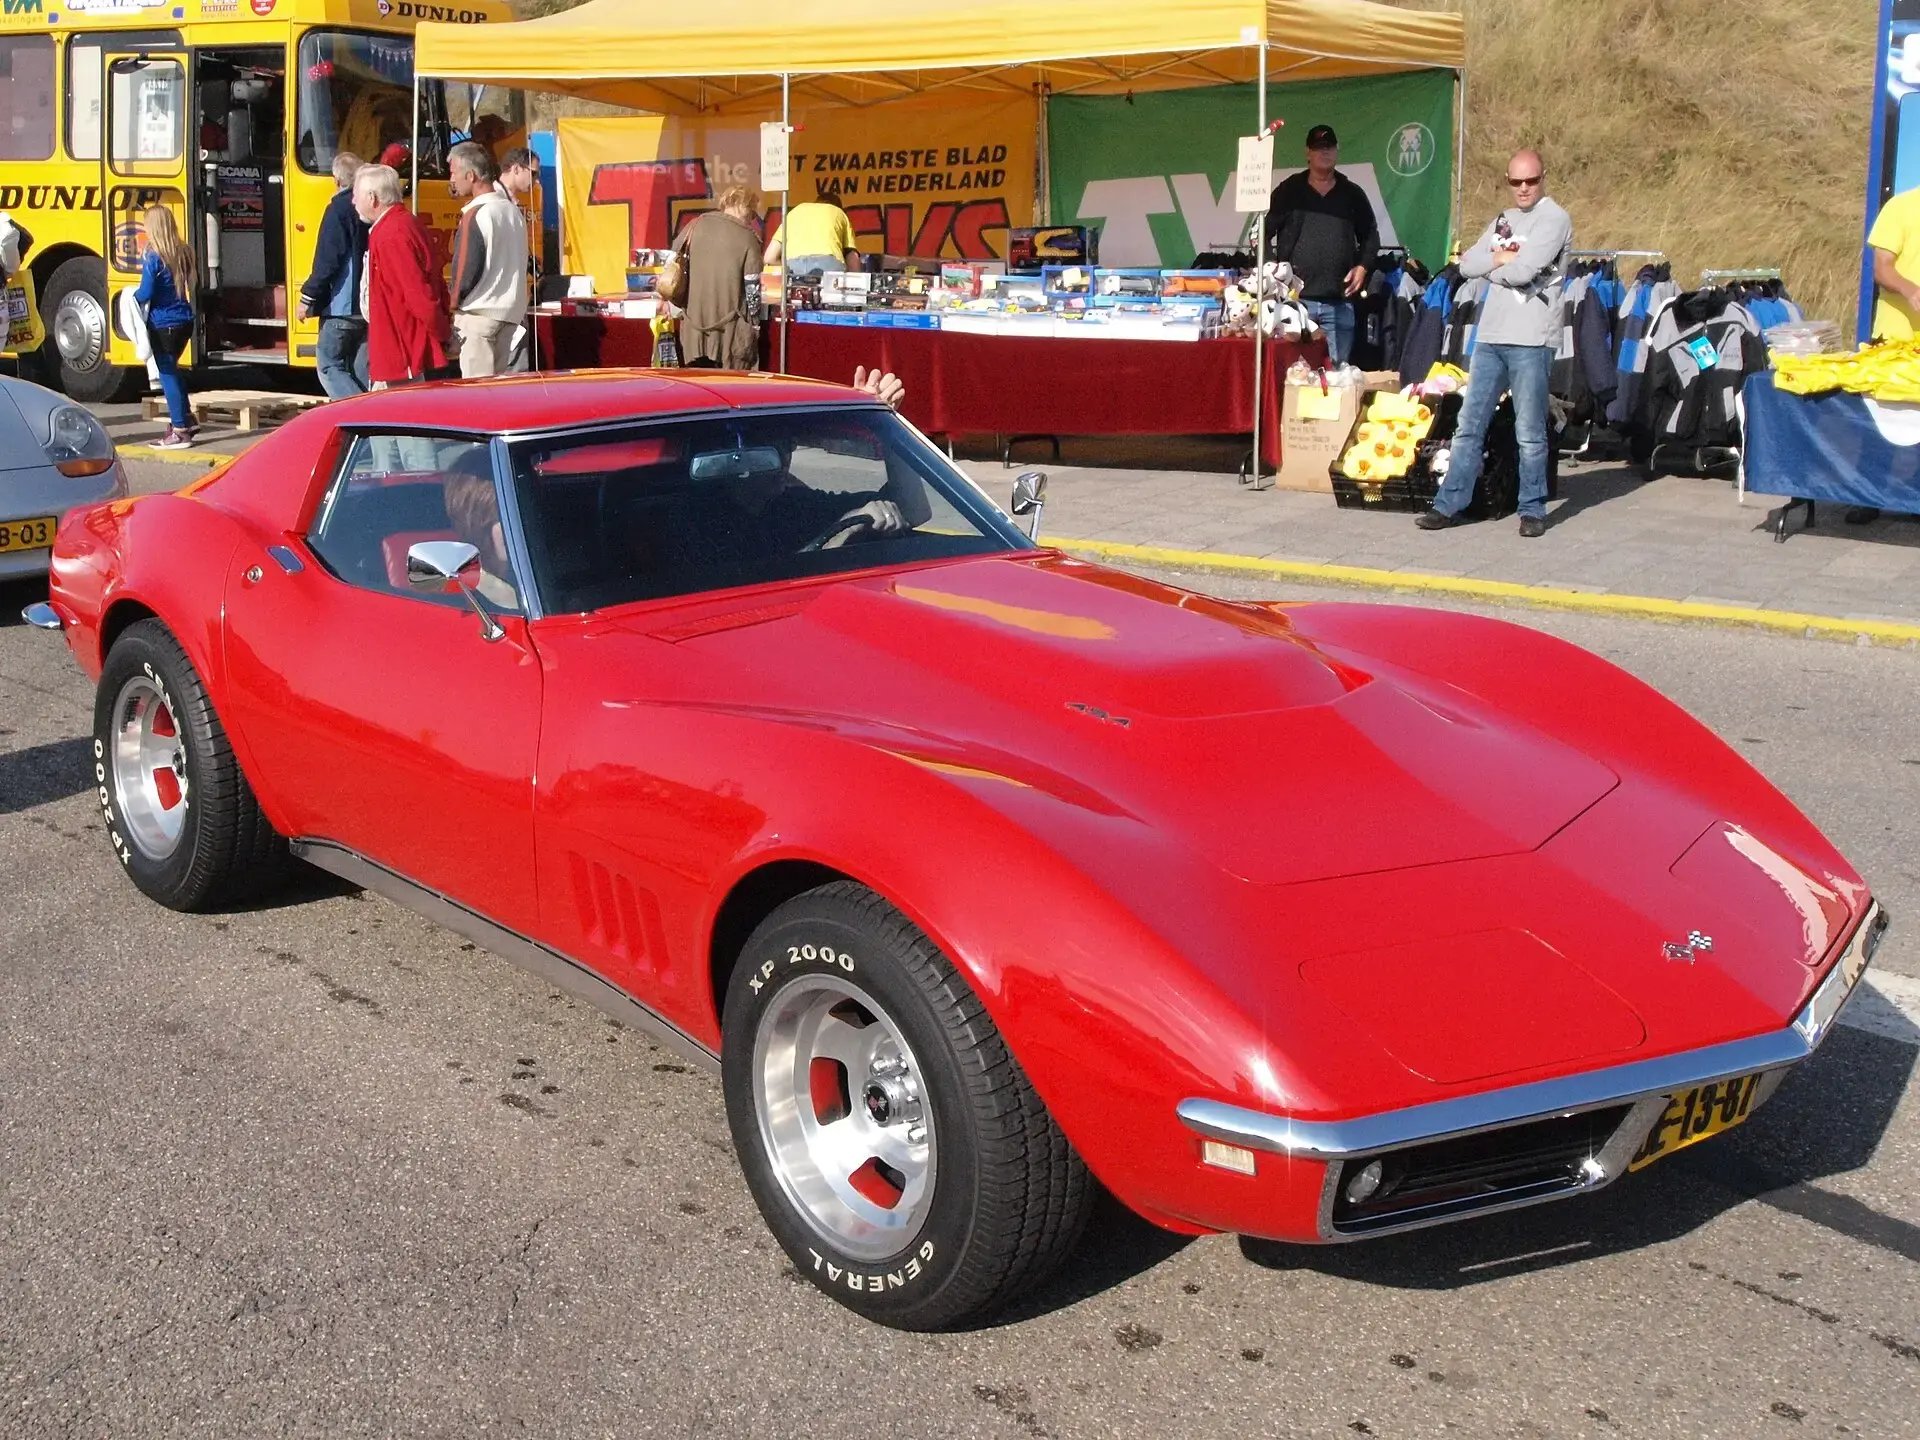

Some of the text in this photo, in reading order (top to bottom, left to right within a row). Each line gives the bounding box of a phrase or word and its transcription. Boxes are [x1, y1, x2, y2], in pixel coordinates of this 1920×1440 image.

[397, 2, 488, 24] DUNLOP
[814, 149, 938, 172] ZWAARSTE
[946, 145, 1008, 166] BLAD
[218, 167, 260, 178] SCANIA
[815, 169, 1006, 195] VAN NEDERLAND
[0, 185, 162, 212] DUNLOP
[749, 944, 855, 996] XP 2000
[809, 1240, 935, 1292] GENERAL
